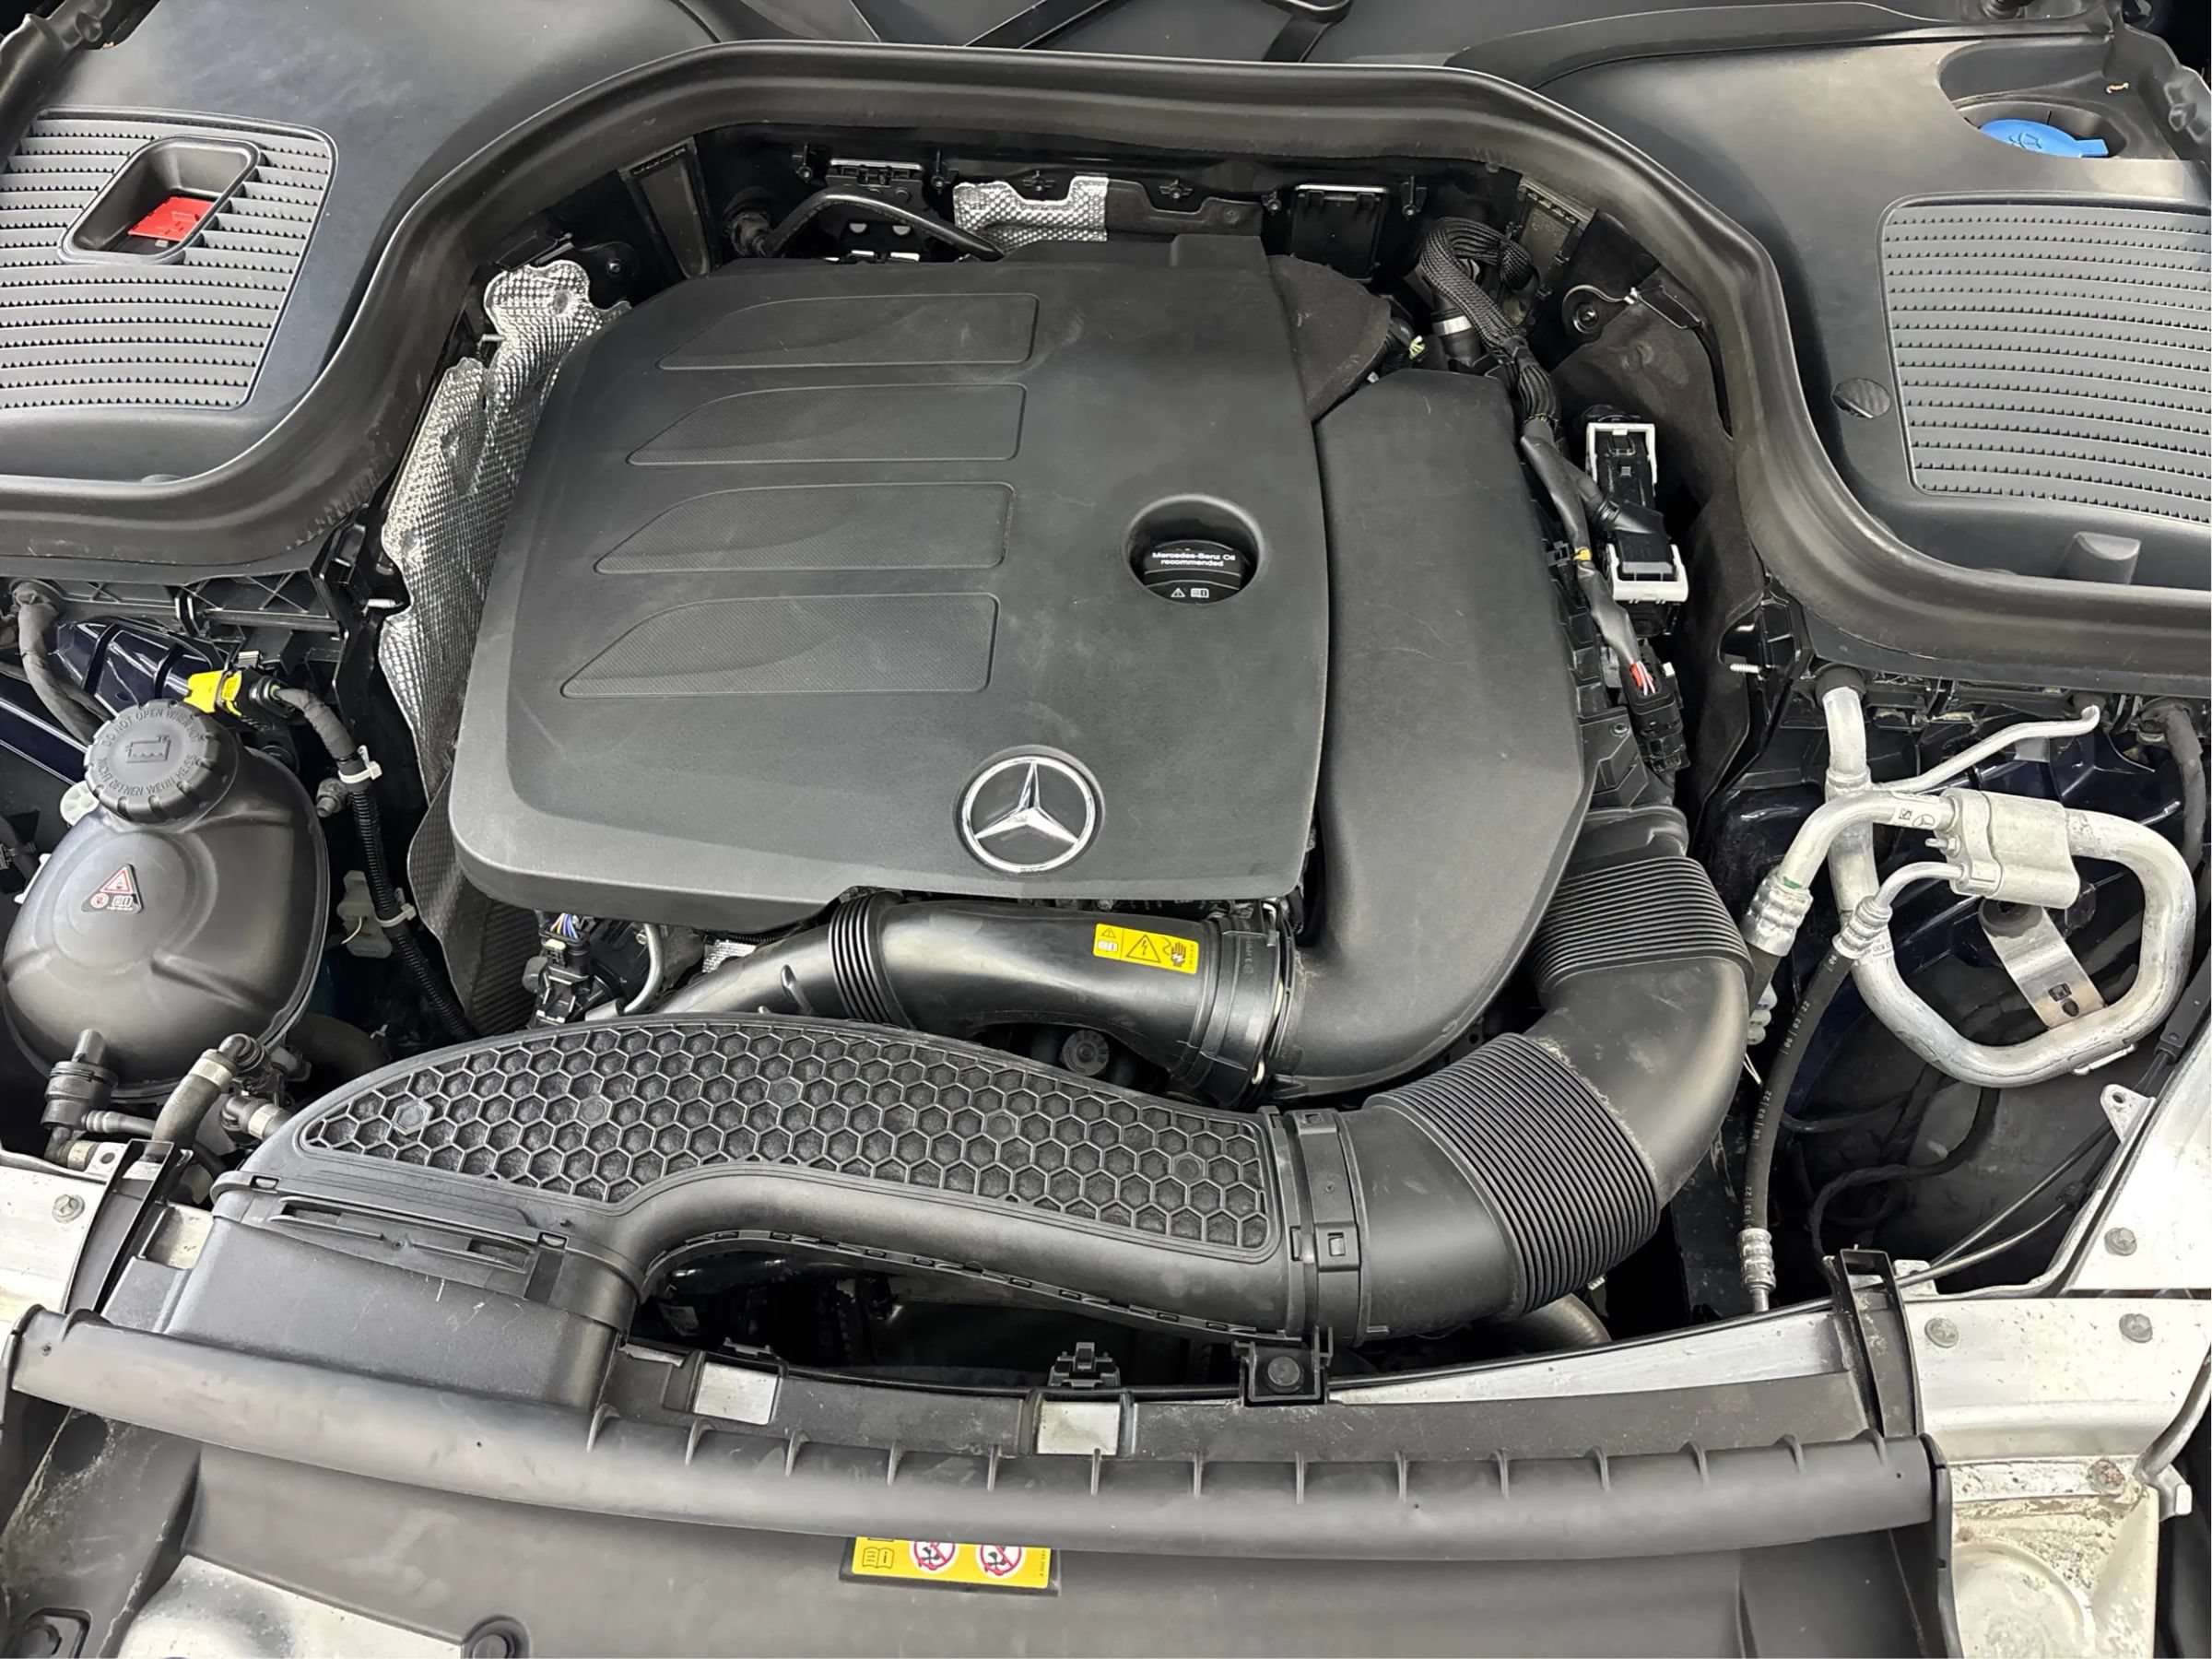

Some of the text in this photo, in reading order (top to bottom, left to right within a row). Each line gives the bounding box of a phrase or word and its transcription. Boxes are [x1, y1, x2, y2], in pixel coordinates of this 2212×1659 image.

[1152, 552, 1236, 561] Mercedes-Benz Oil
[1160, 559, 1224, 567] recommended
[100, 733, 116, 747] DO
[113, 715, 132, 734] NOT
[135, 708, 164, 721] OPEN
[167, 709, 192, 728] WHEN
[97, 757, 113, 782] NICHT
[147, 776, 176, 794] WENN
